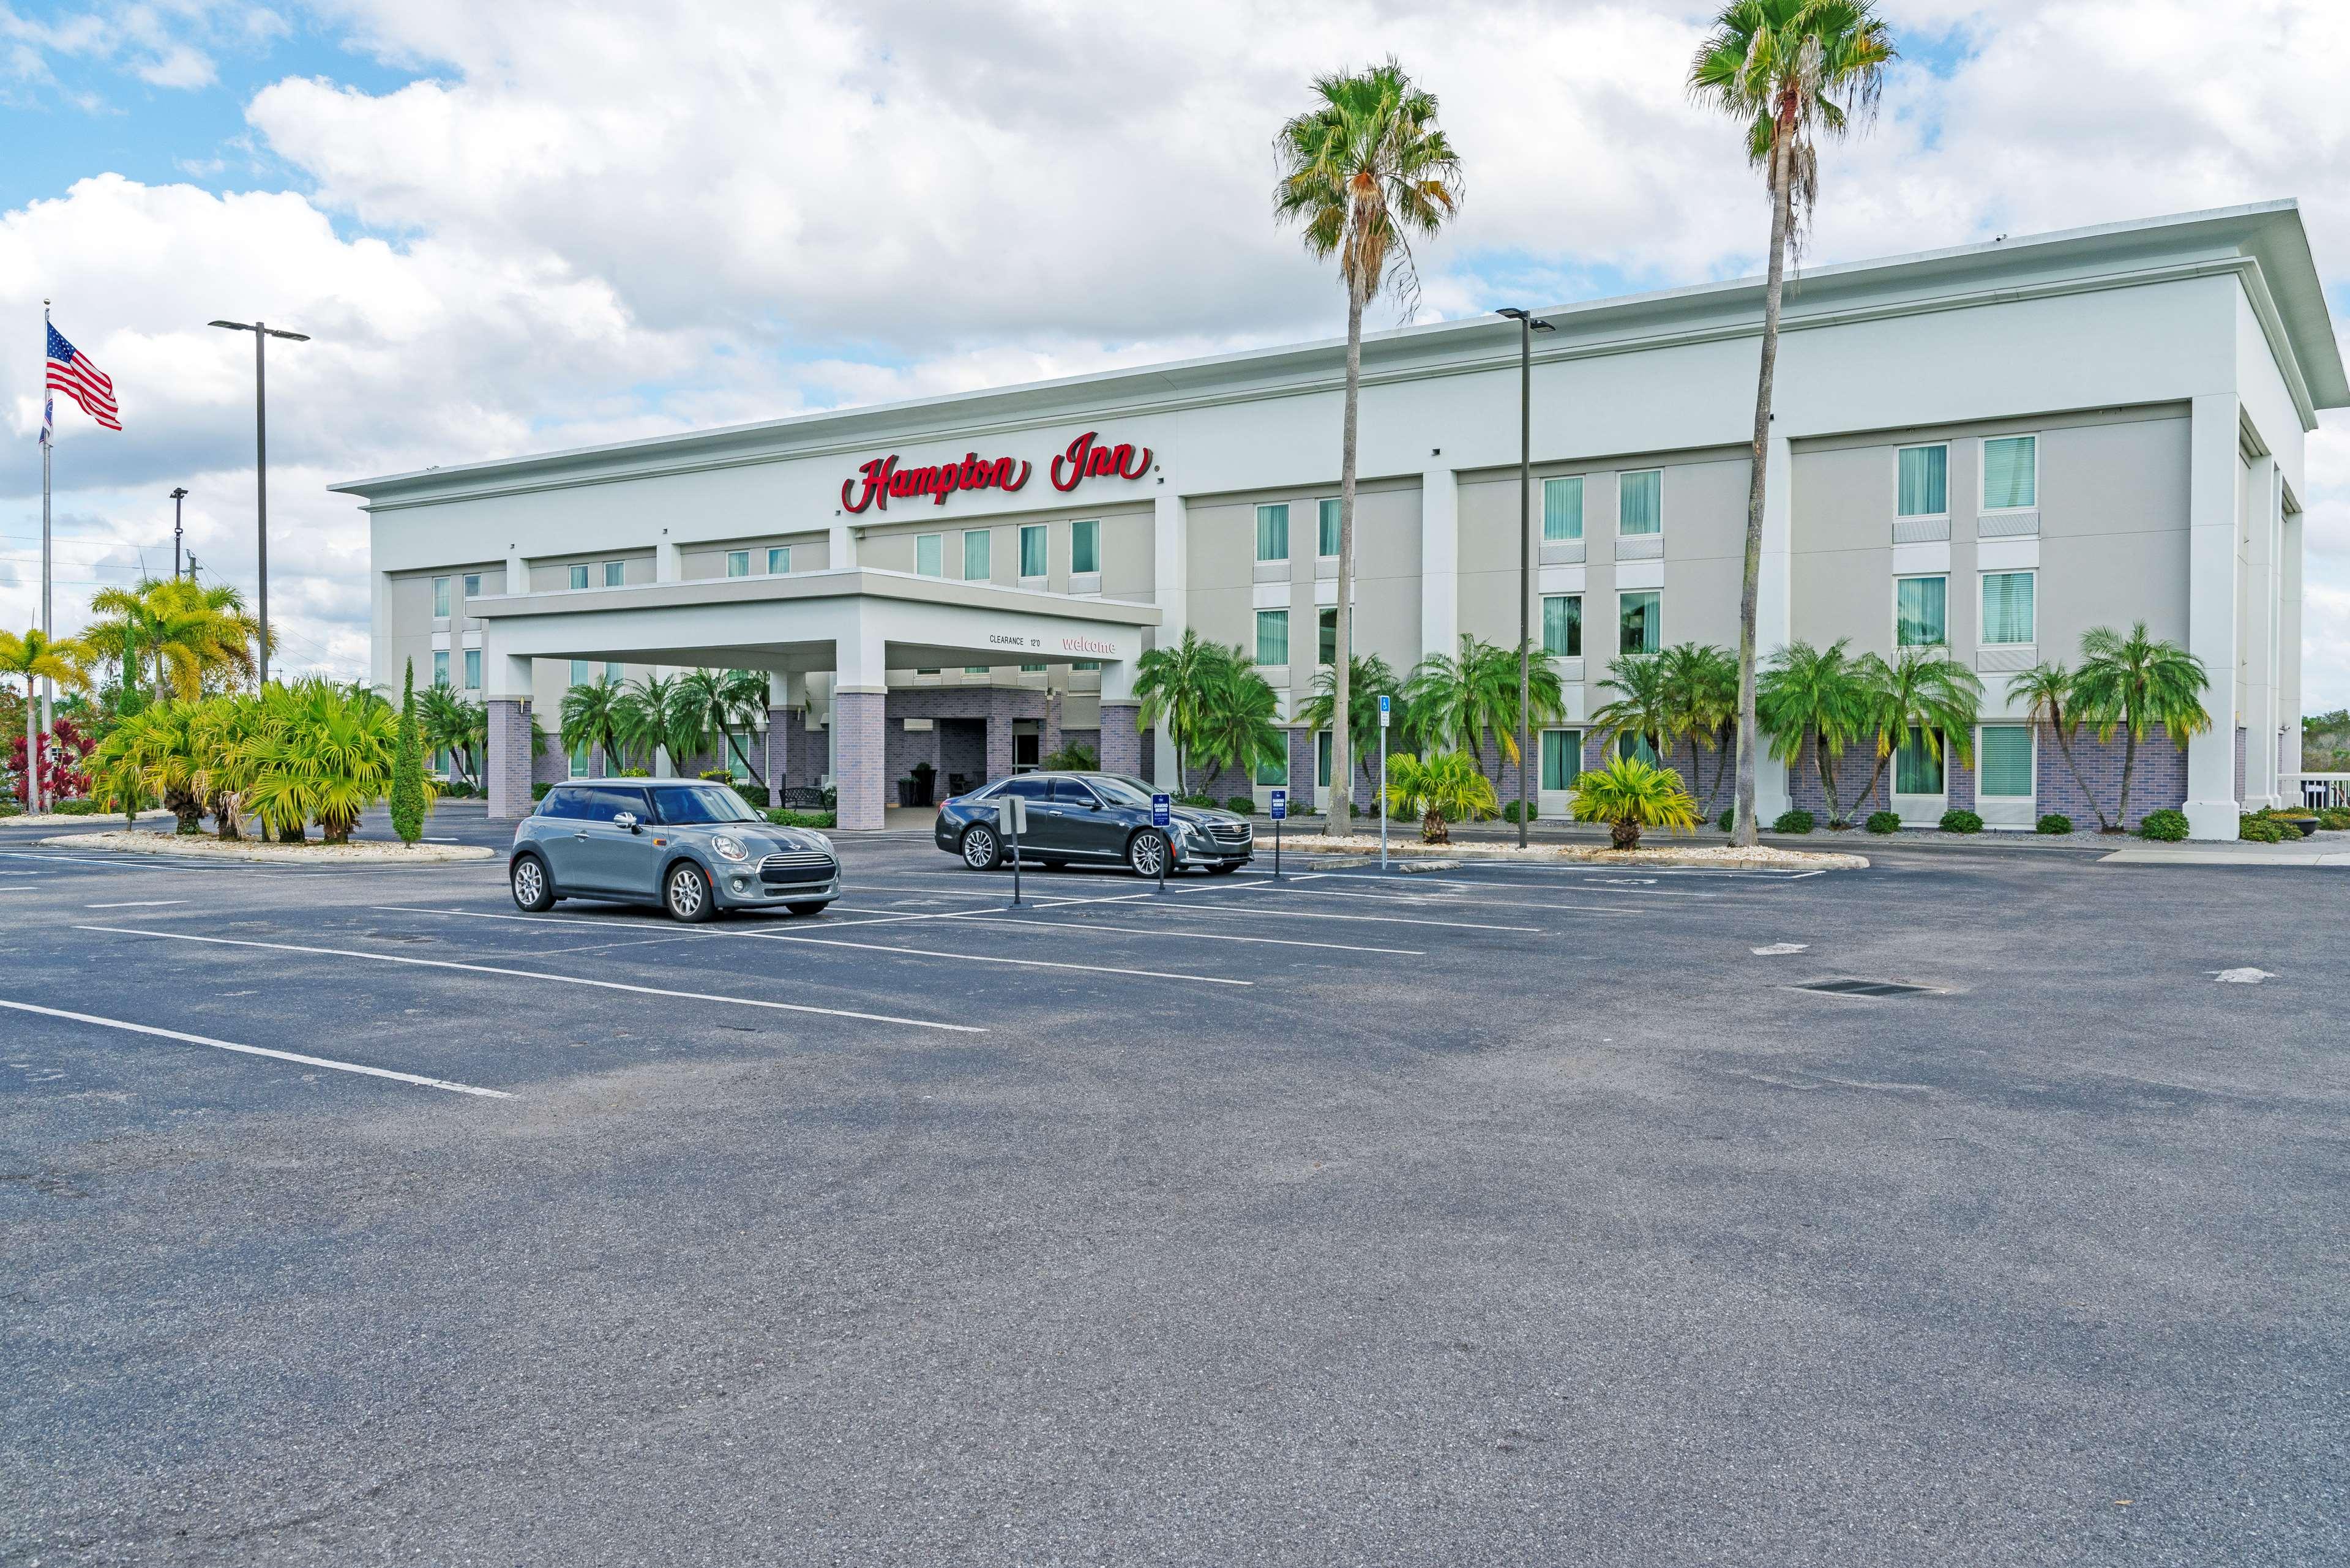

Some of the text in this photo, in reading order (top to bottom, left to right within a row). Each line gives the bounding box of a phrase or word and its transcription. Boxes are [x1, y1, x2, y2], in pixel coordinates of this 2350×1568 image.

[842, 431, 1154, 514] Hampton Inn
[989, 634, 1024, 646] CLEARANCE
[1063, 636, 1117, 654] welcome
